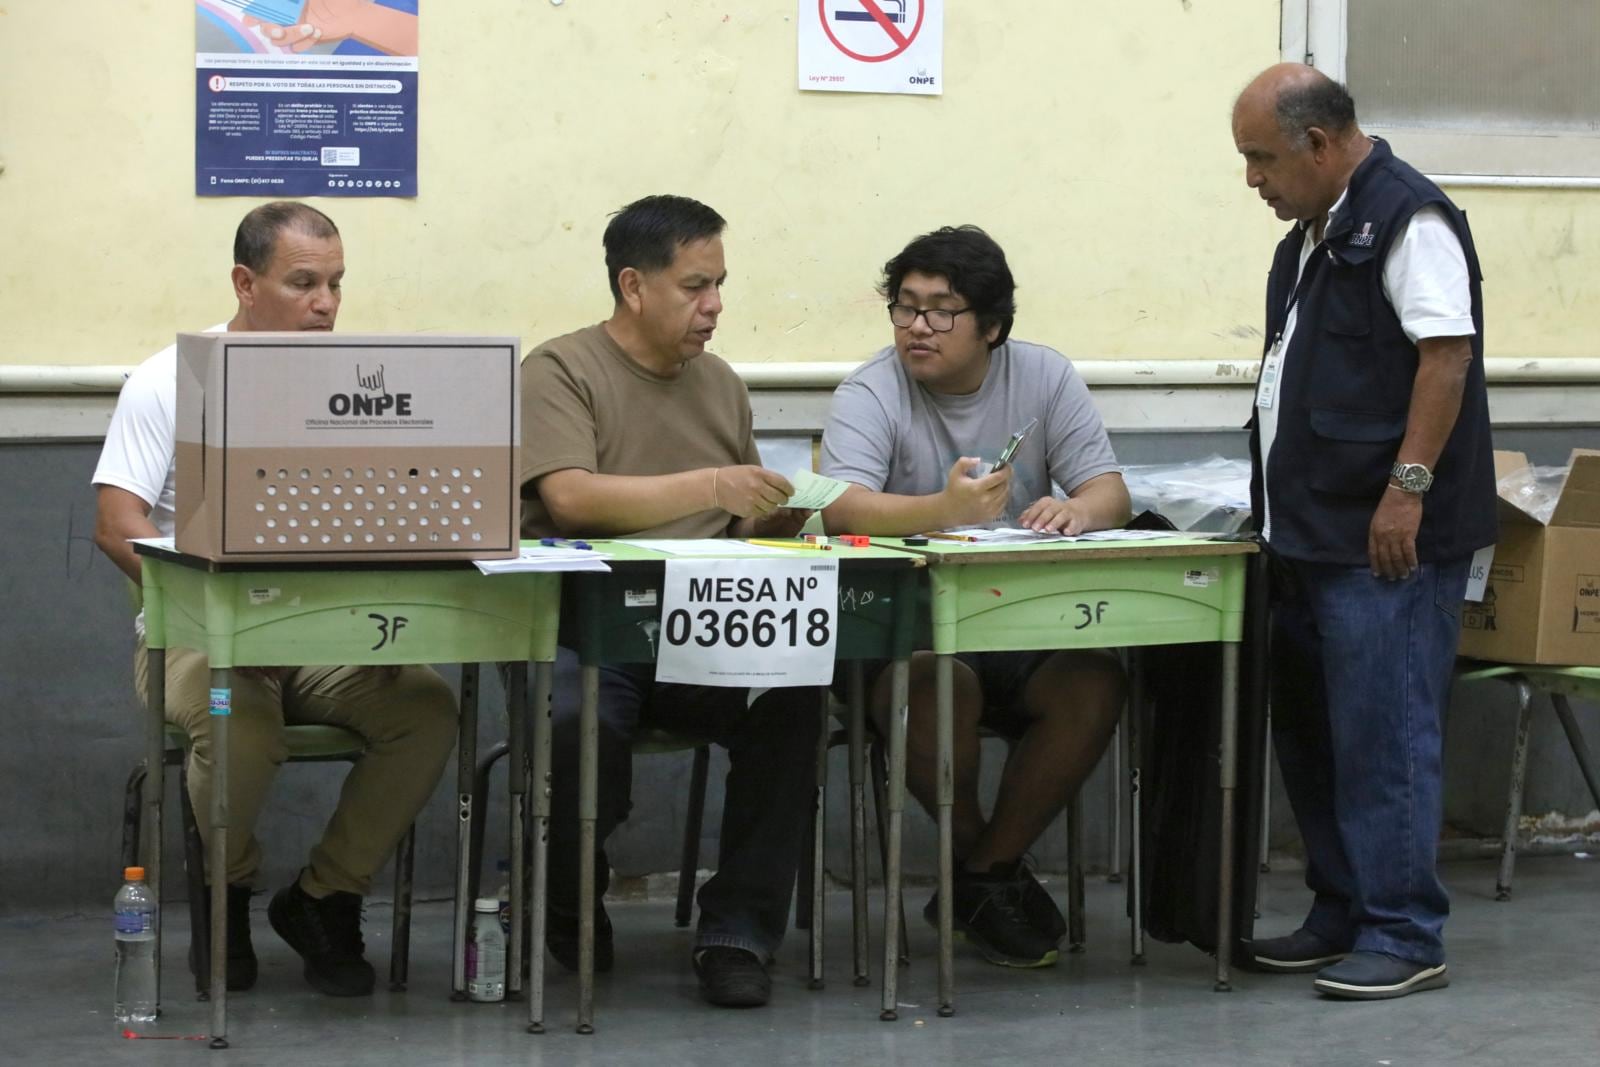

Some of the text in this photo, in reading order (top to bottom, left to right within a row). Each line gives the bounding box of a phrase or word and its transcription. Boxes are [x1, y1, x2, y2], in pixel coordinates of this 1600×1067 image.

[909, 76, 934, 84] ONPE
[328, 393, 412, 416] ONPE
[689, 578, 776, 602] MESA
[1579, 588, 1600, 597] ONPE
[1075, 600, 1110, 630] 3F
[666, 608, 830, 647] 036618
